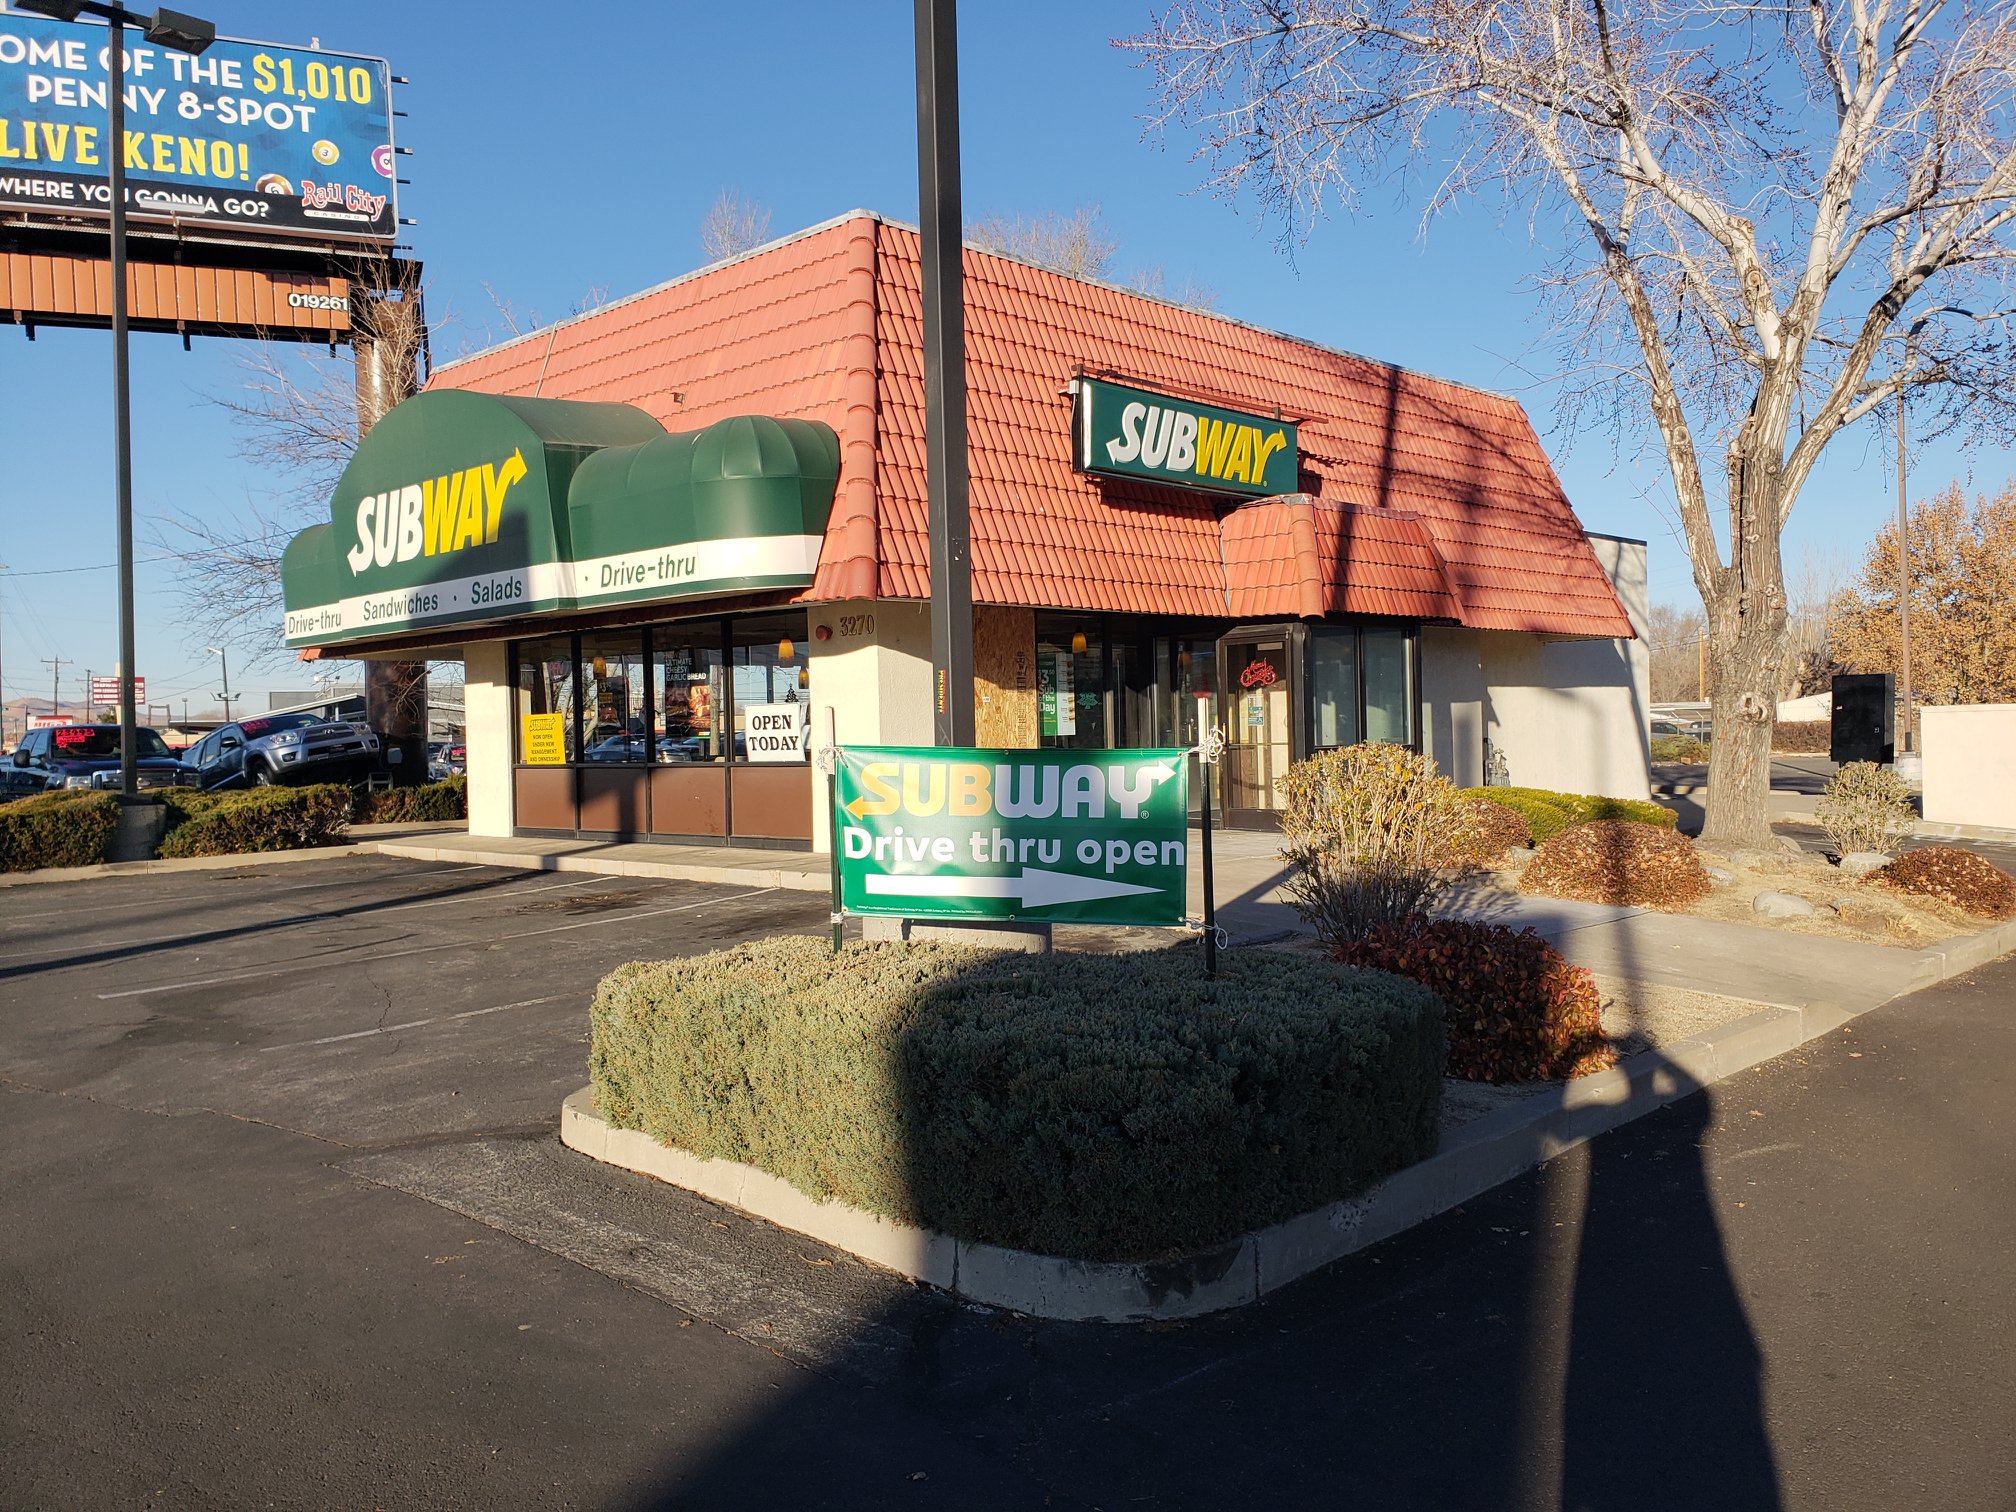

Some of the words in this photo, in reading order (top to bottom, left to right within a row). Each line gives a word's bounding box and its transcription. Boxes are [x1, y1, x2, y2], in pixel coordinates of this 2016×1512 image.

[99, 46, 155, 77] OF
[165, 52, 243, 89] THE
[253, 53, 371, 104] $1,010
[28, 74, 166, 115] PENNY
[177, 91, 316, 133] 8-SPOT
[0, 119, 99, 165] LIVE
[124, 130, 249, 181] KENO!
[322, 149, 329, 157] 3
[0, 177, 75, 200] WHERE
[224, 198, 270, 218] GO?
[301, 180, 343, 208] Rail
[346, 185, 386, 222] City
[314, 211, 360, 219] CASINO
[288, 293, 349, 311] 019261
[1106, 402, 1287, 487] SUBWAY
[347, 447, 528, 577] SUBWAY
[601, 554, 696, 588] Drive-thru
[363, 593, 439, 622] Sandwiches
[471, 576, 523, 605] Salads
[288, 610, 342, 634] Drive-thru
[840, 614, 875, 636] 3270
[666, 665, 688, 673] CHEESY
[666, 673, 686, 681] GARLIC
[1038, 684, 1055, 695] Sub
[1045, 694, 1055, 702] the
[1039, 702, 1056, 714] Day
[752, 715, 792, 730] OPEN
[749, 736, 799, 751] TODAY
[844, 760, 1176, 820] SUBWAY
[843, 826, 955, 863] Drive
[969, 828, 1061, 863] thru
[1076, 839, 1185, 874] open
